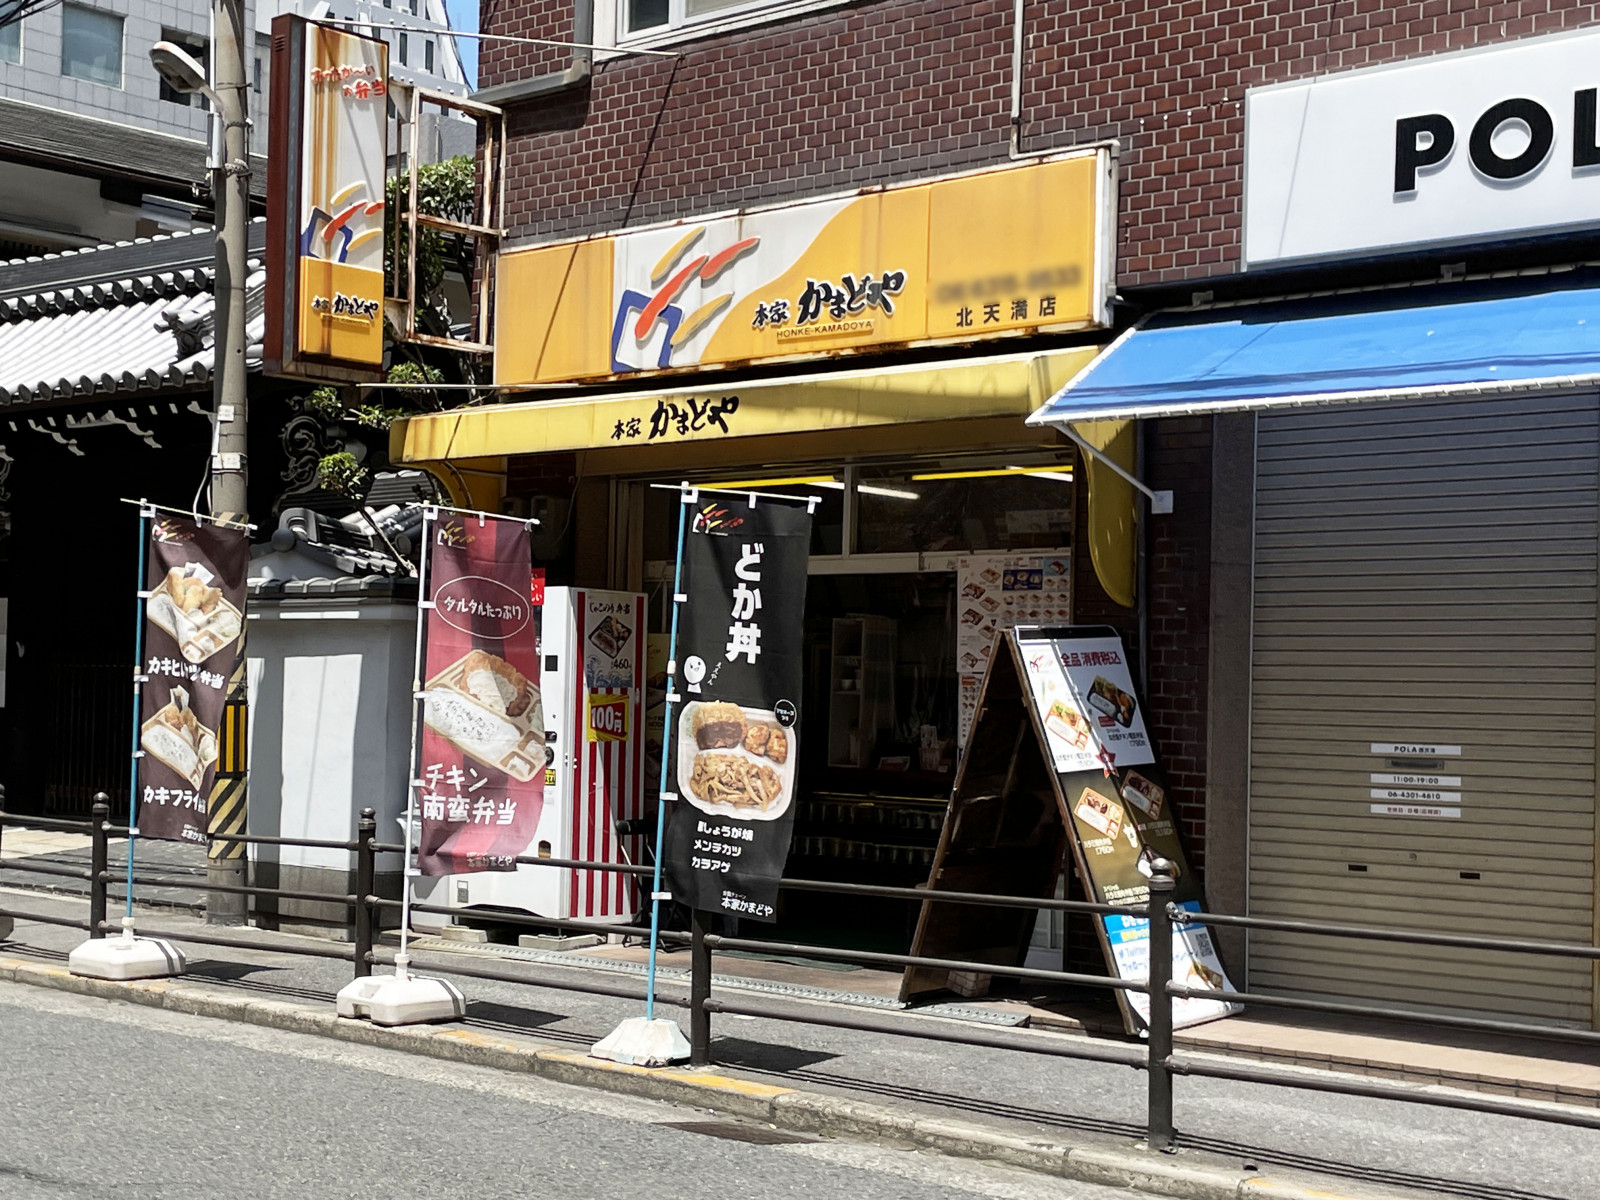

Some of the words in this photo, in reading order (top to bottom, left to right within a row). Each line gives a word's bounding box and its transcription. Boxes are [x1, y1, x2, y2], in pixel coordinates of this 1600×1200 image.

[343, 77, 386, 99] お弁当
[956, 297, 1057, 327] 北天満店
[776, 320, 873, 339] HONKE-KAMADOYA
[443, 595, 521, 620] タルタルたっぷり
[725, 543, 765, 664] どか丼
[426, 763, 488, 793] チキン
[423, 792, 518, 826] 南蛮弁当
[693, 839, 742, 857] メンチカツ
[691, 855, 731, 873] カラアゲ
[721, 896, 774, 917] 本家かまどや
